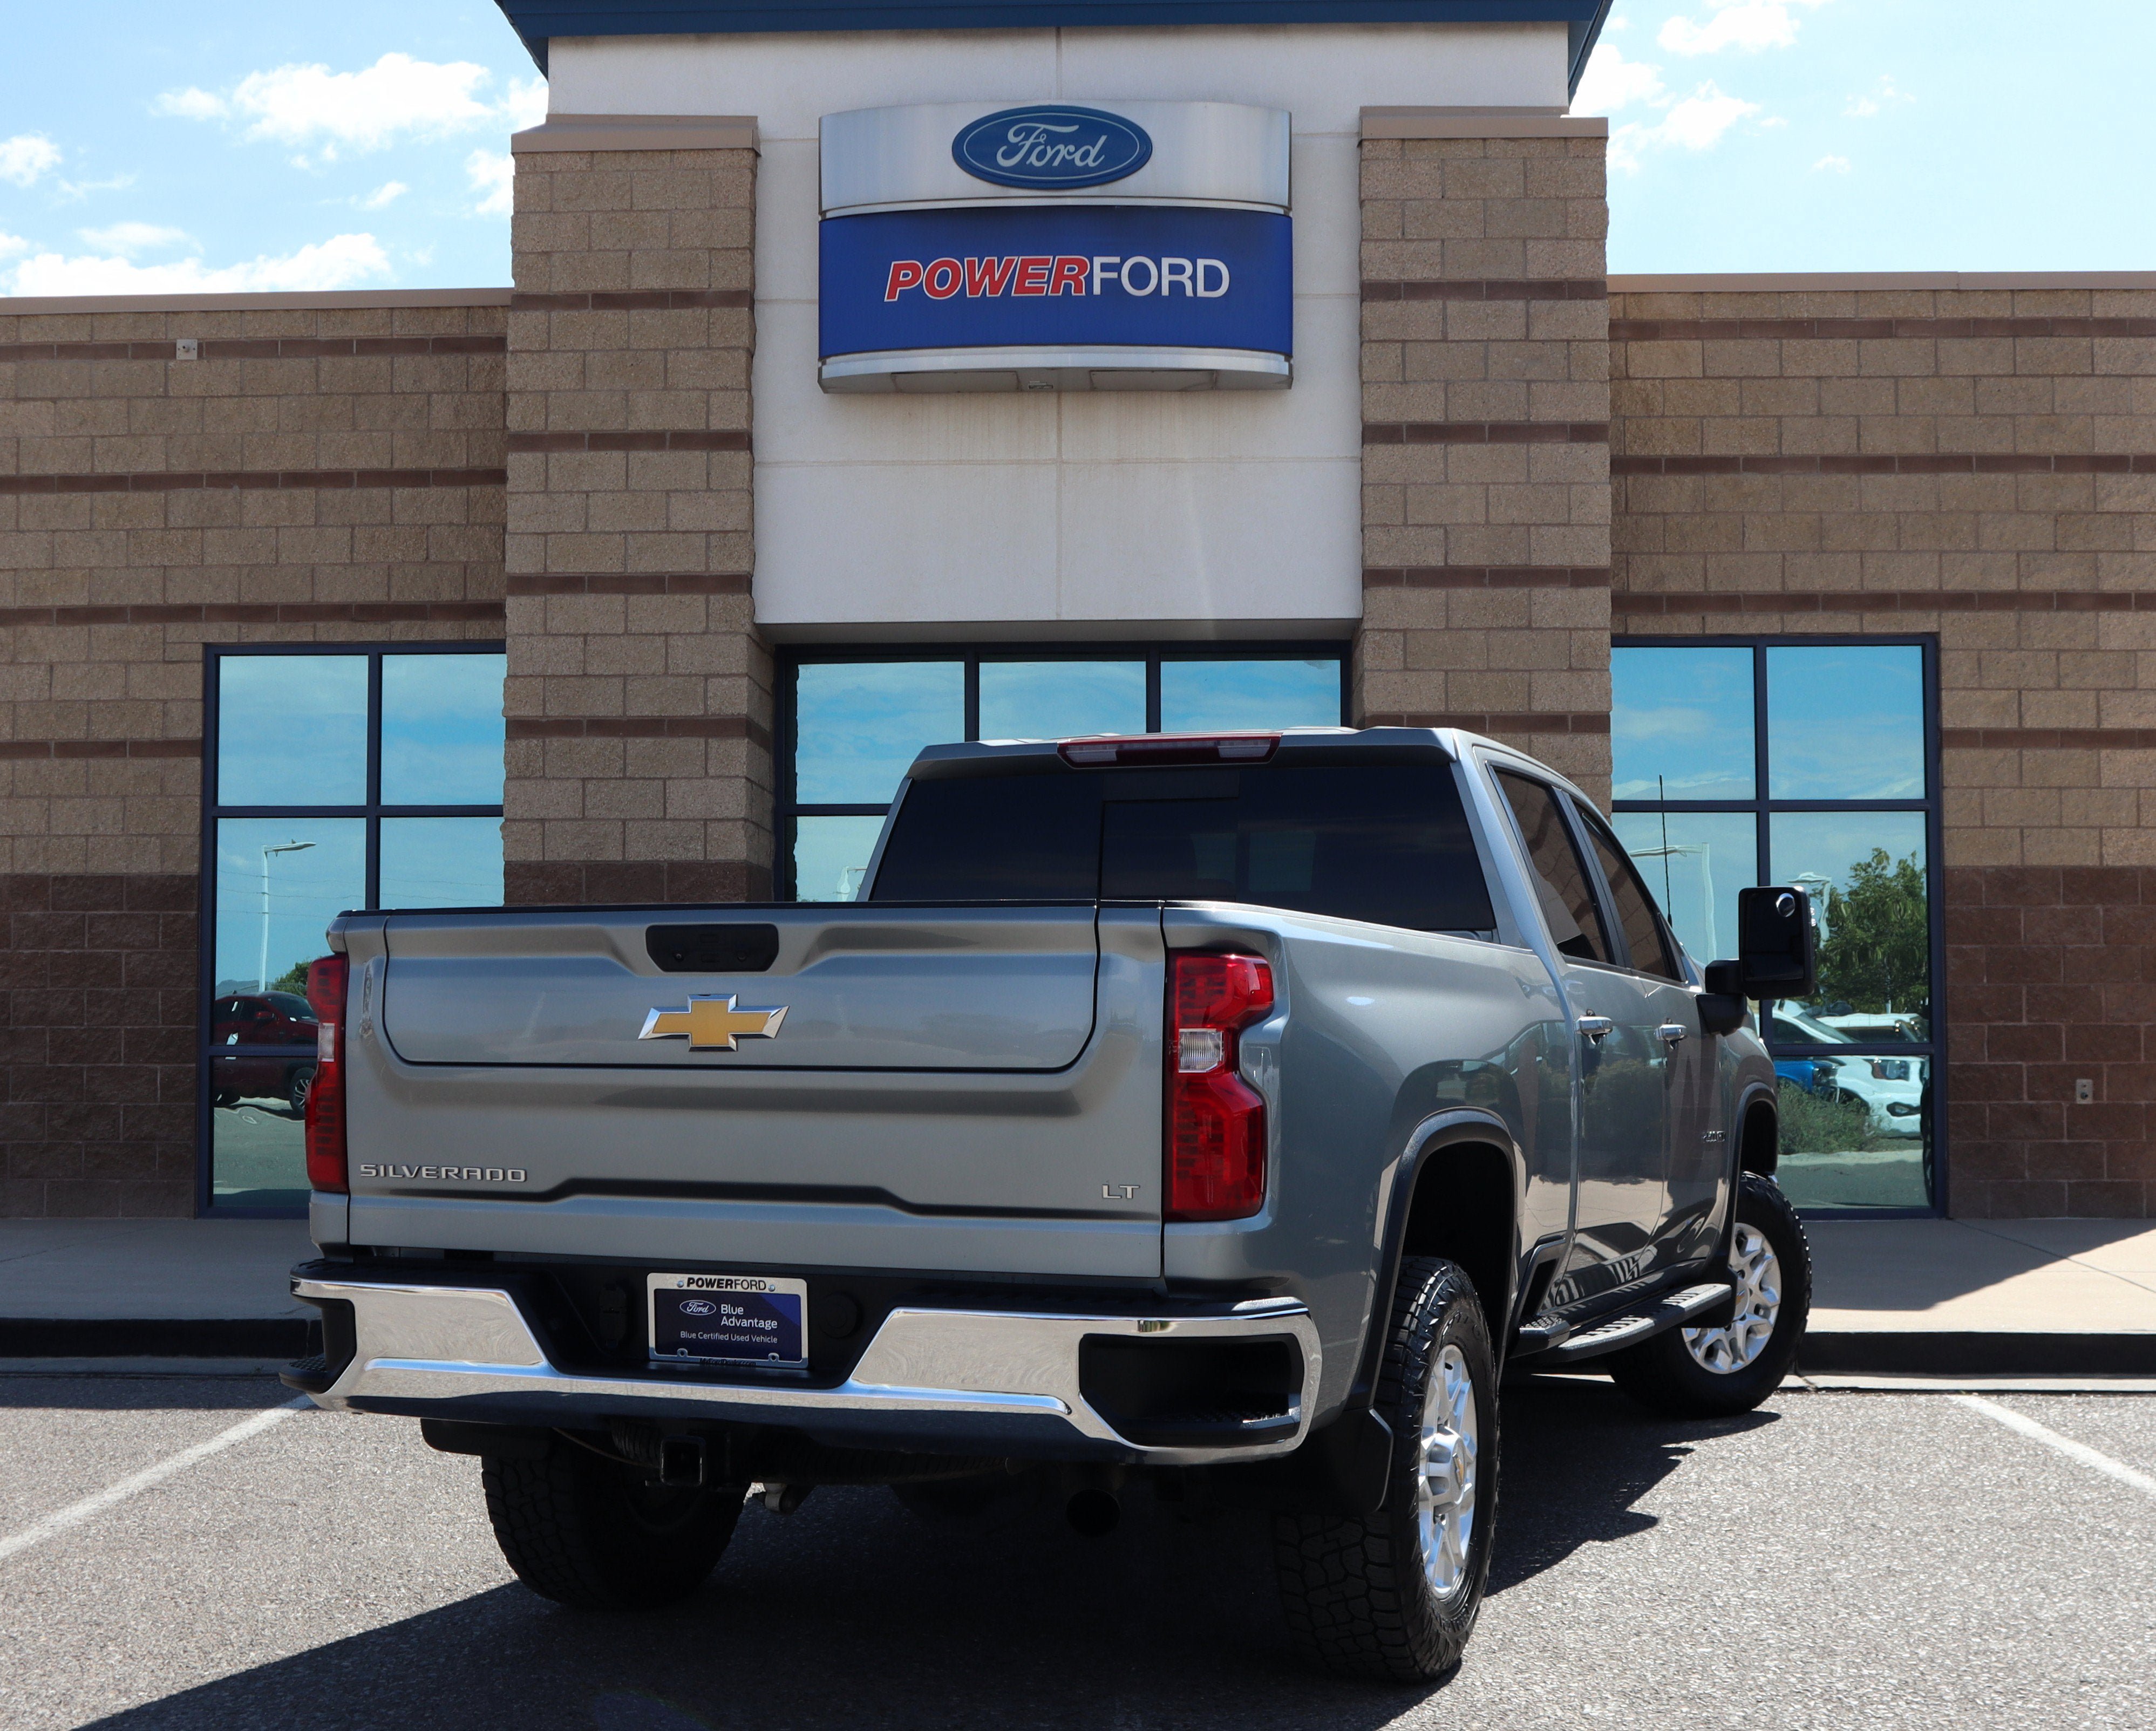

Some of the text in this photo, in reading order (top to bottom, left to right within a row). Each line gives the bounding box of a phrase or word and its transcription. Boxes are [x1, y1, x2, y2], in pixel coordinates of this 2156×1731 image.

[996, 122, 1108, 168] Ford
[883, 254, 1231, 303] POWERFORD
[360, 1164, 528, 1182] SILVERADO
[1102, 1184, 1140, 1199] LT
[686, 1277, 767, 1291] POWERFORD
[686, 1301, 709, 1313] Ford
[720, 1304, 744, 1315] Blue
[720, 1316, 778, 1331] Advantage
[680, 1331, 778, 1344] Blue Certified Used Vehicle
